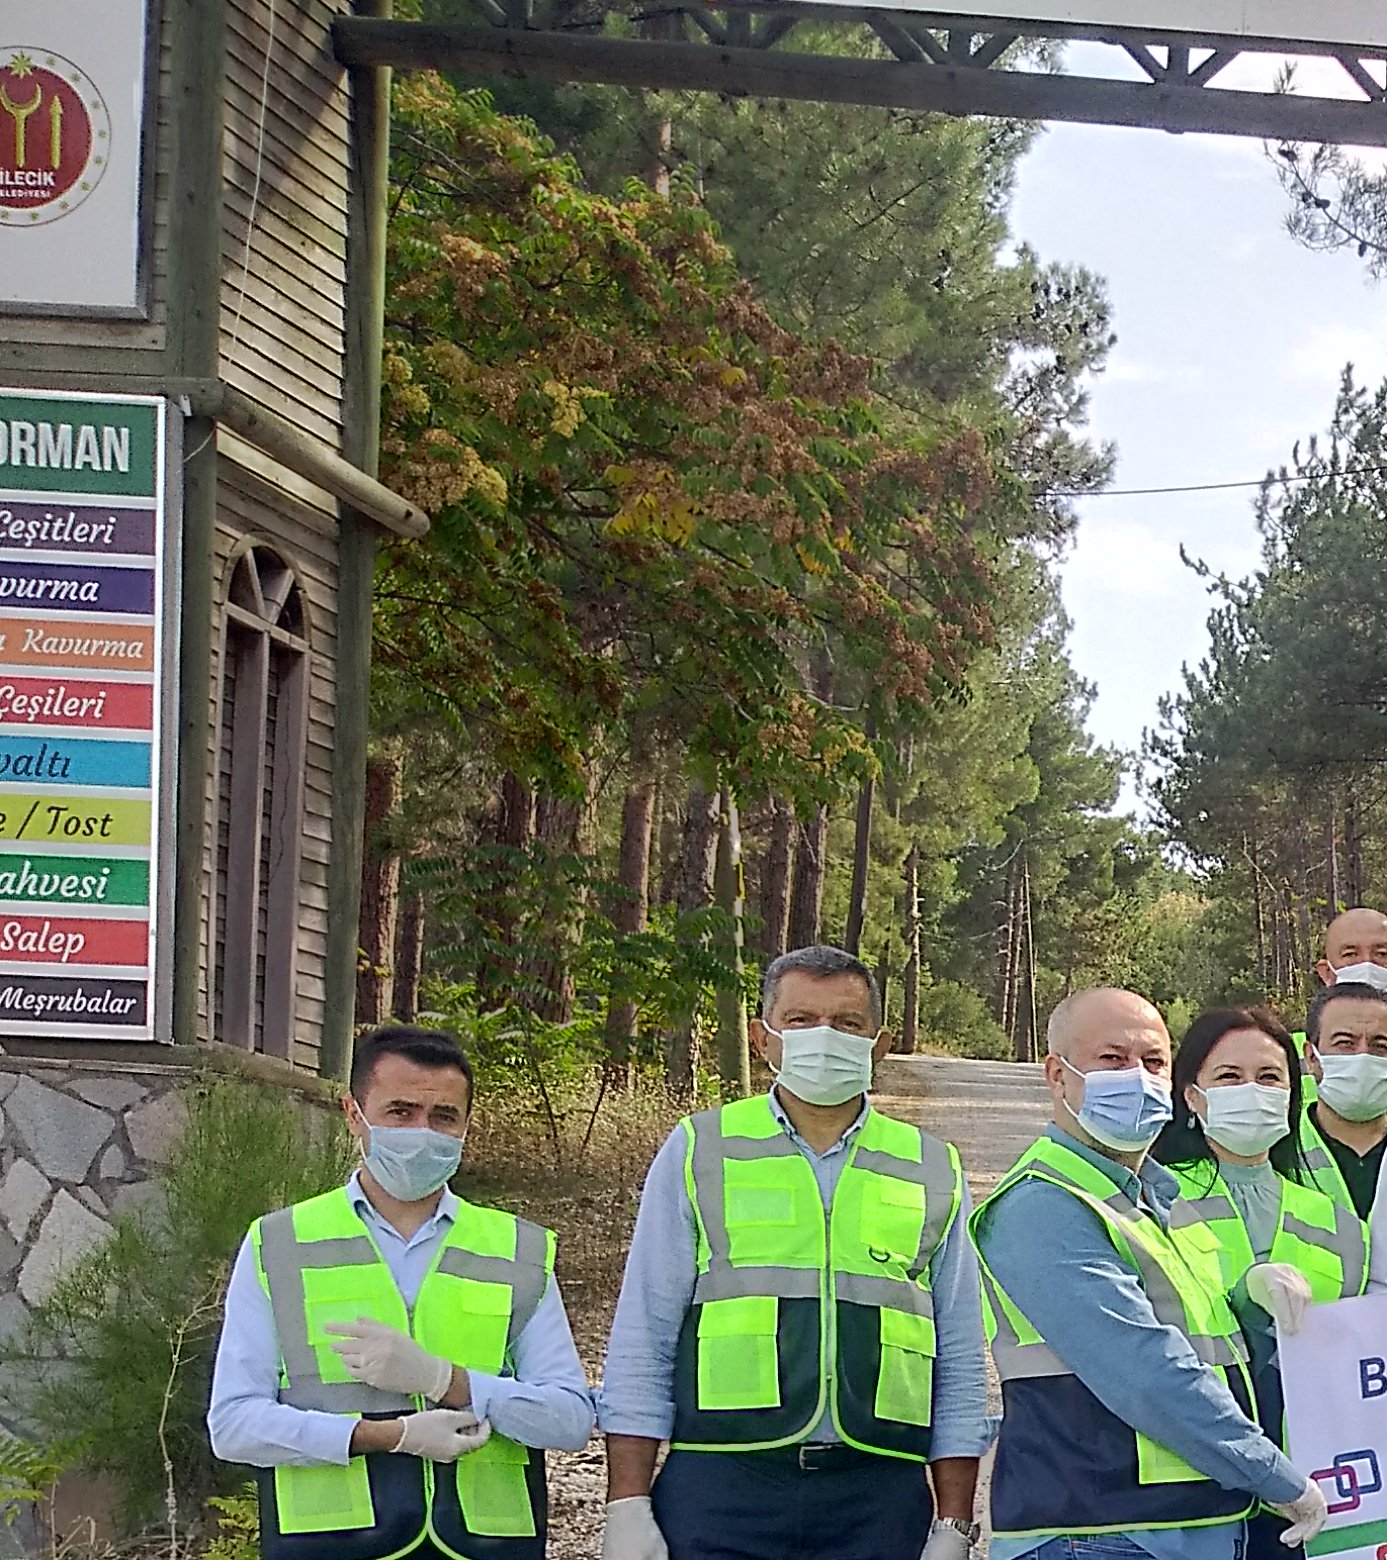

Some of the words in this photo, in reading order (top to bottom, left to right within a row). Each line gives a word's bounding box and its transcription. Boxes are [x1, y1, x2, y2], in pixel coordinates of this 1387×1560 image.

[22, 628, 145, 659] Kavurma
[47, 805, 114, 837] Tost
[0, 921, 86, 963] Salep
[0, 986, 138, 1017] Meşrubalar
